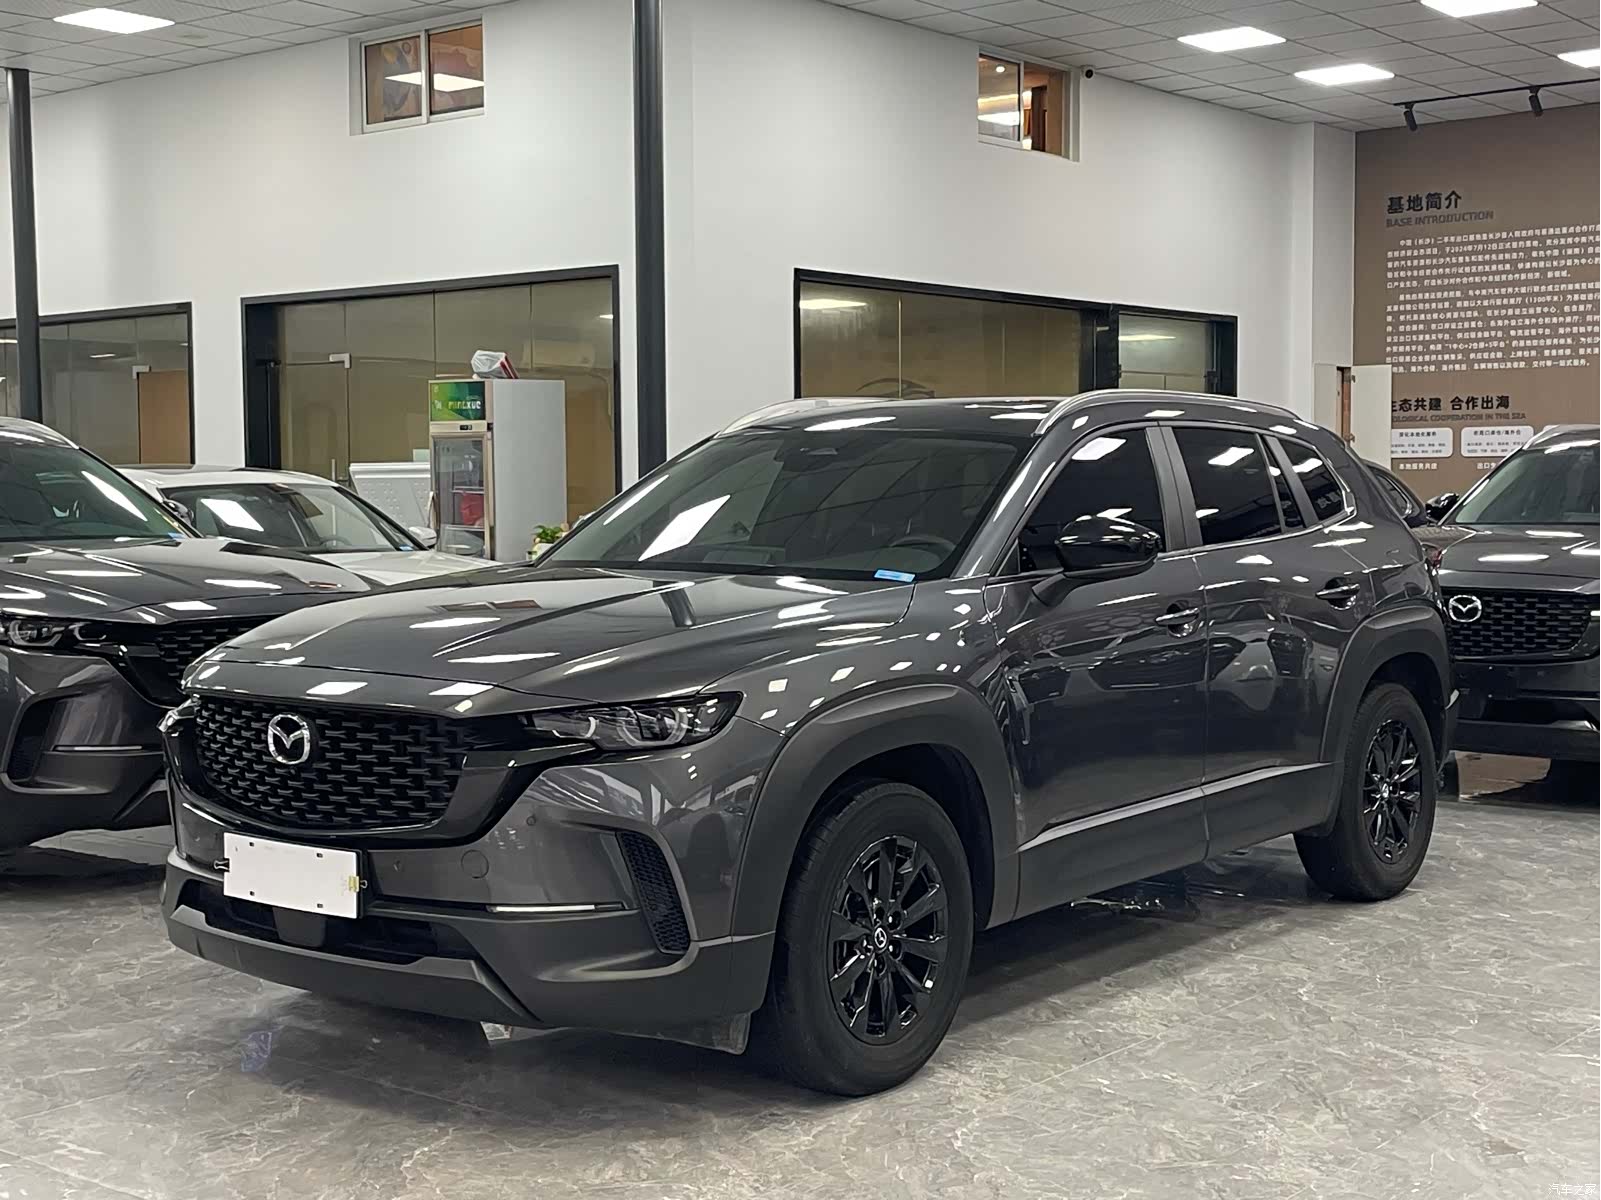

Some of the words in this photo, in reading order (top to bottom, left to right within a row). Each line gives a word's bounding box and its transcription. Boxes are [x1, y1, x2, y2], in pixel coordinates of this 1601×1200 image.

[1386, 190, 1462, 214] 基地简介
[1386, 217, 1412, 228] BASE
[1415, 210, 1494, 225] INTRODUCTION
[1450, 395, 1510, 411] 合作出海
